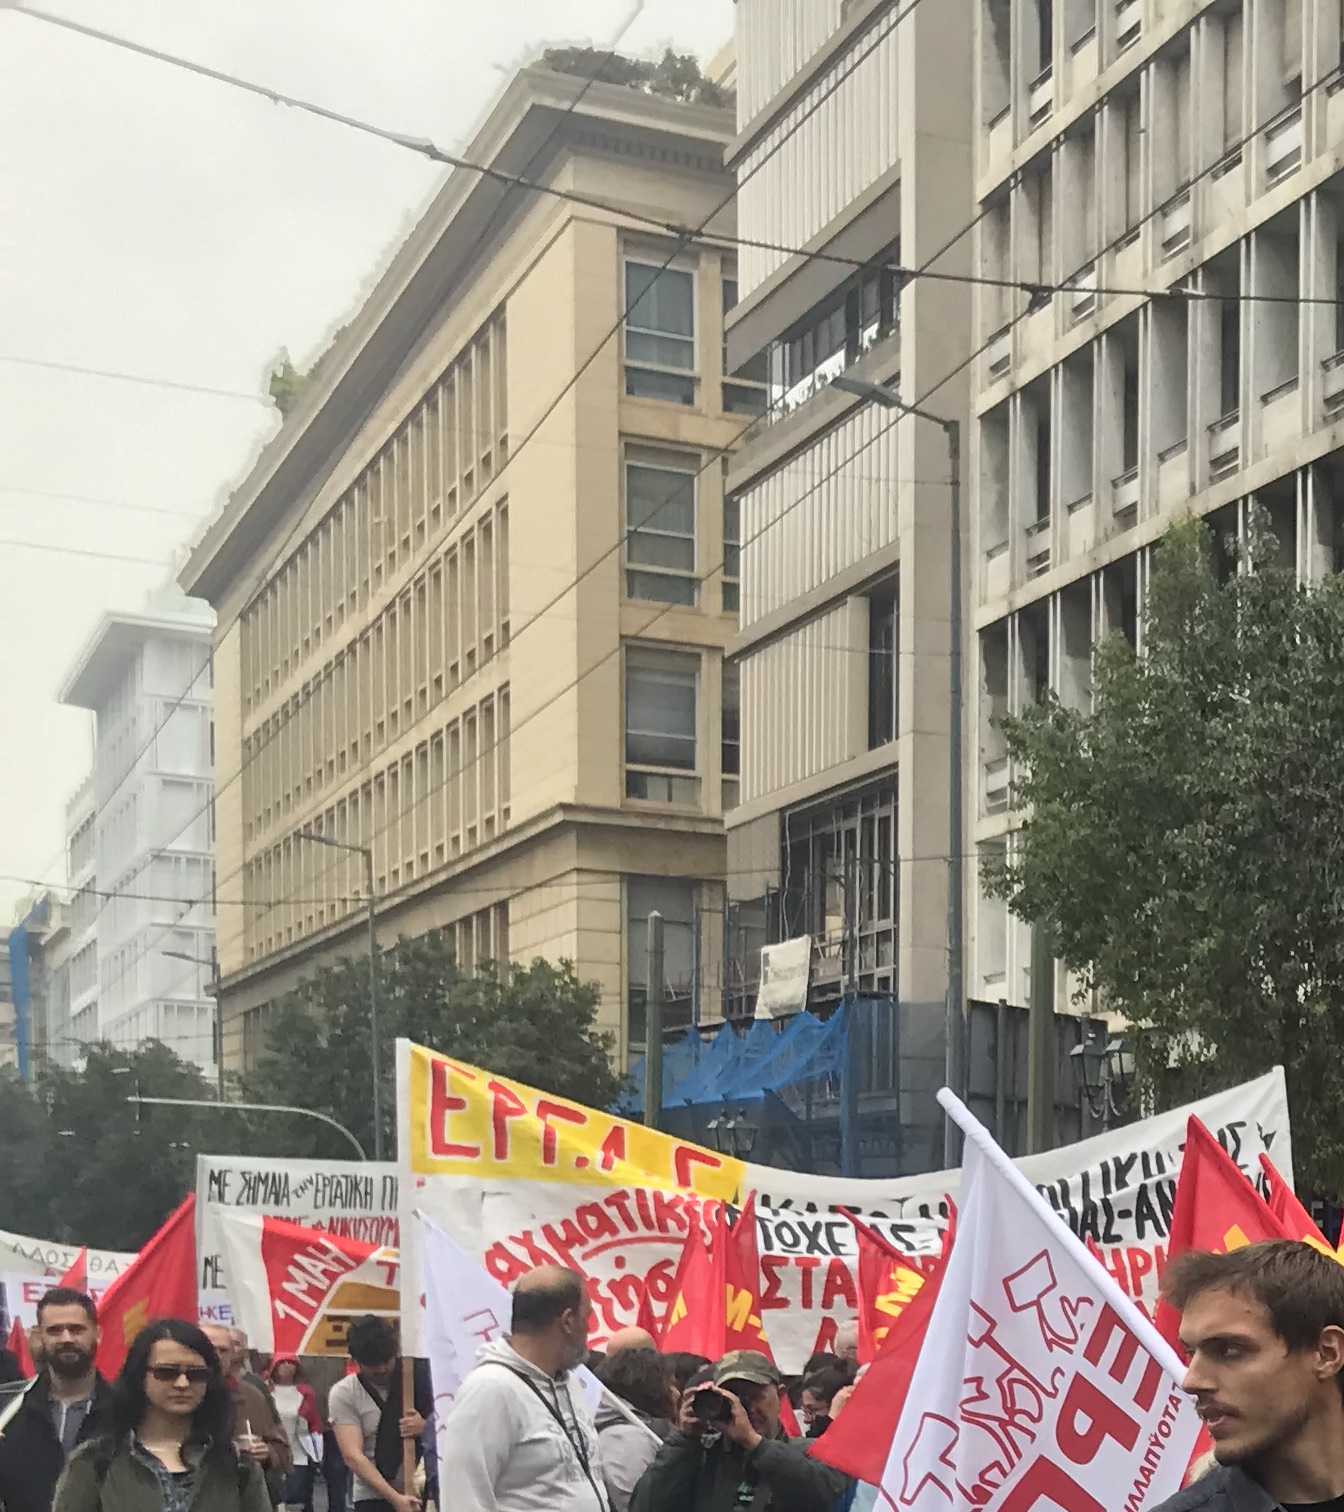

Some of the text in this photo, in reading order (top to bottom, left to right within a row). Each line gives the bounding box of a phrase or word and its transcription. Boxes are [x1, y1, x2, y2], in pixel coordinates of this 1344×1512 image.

[207, 1168, 233, 1206] ΜΕ
[235, 1170, 291, 1208] ΣΗΜΑΙΑ
[313, 1172, 374, 1212] ΕΡΓΑΤΙΚΗ
[203, 1254, 227, 1290] ΜΕ
[281, 1237, 358, 1309] ΜΑΗ
